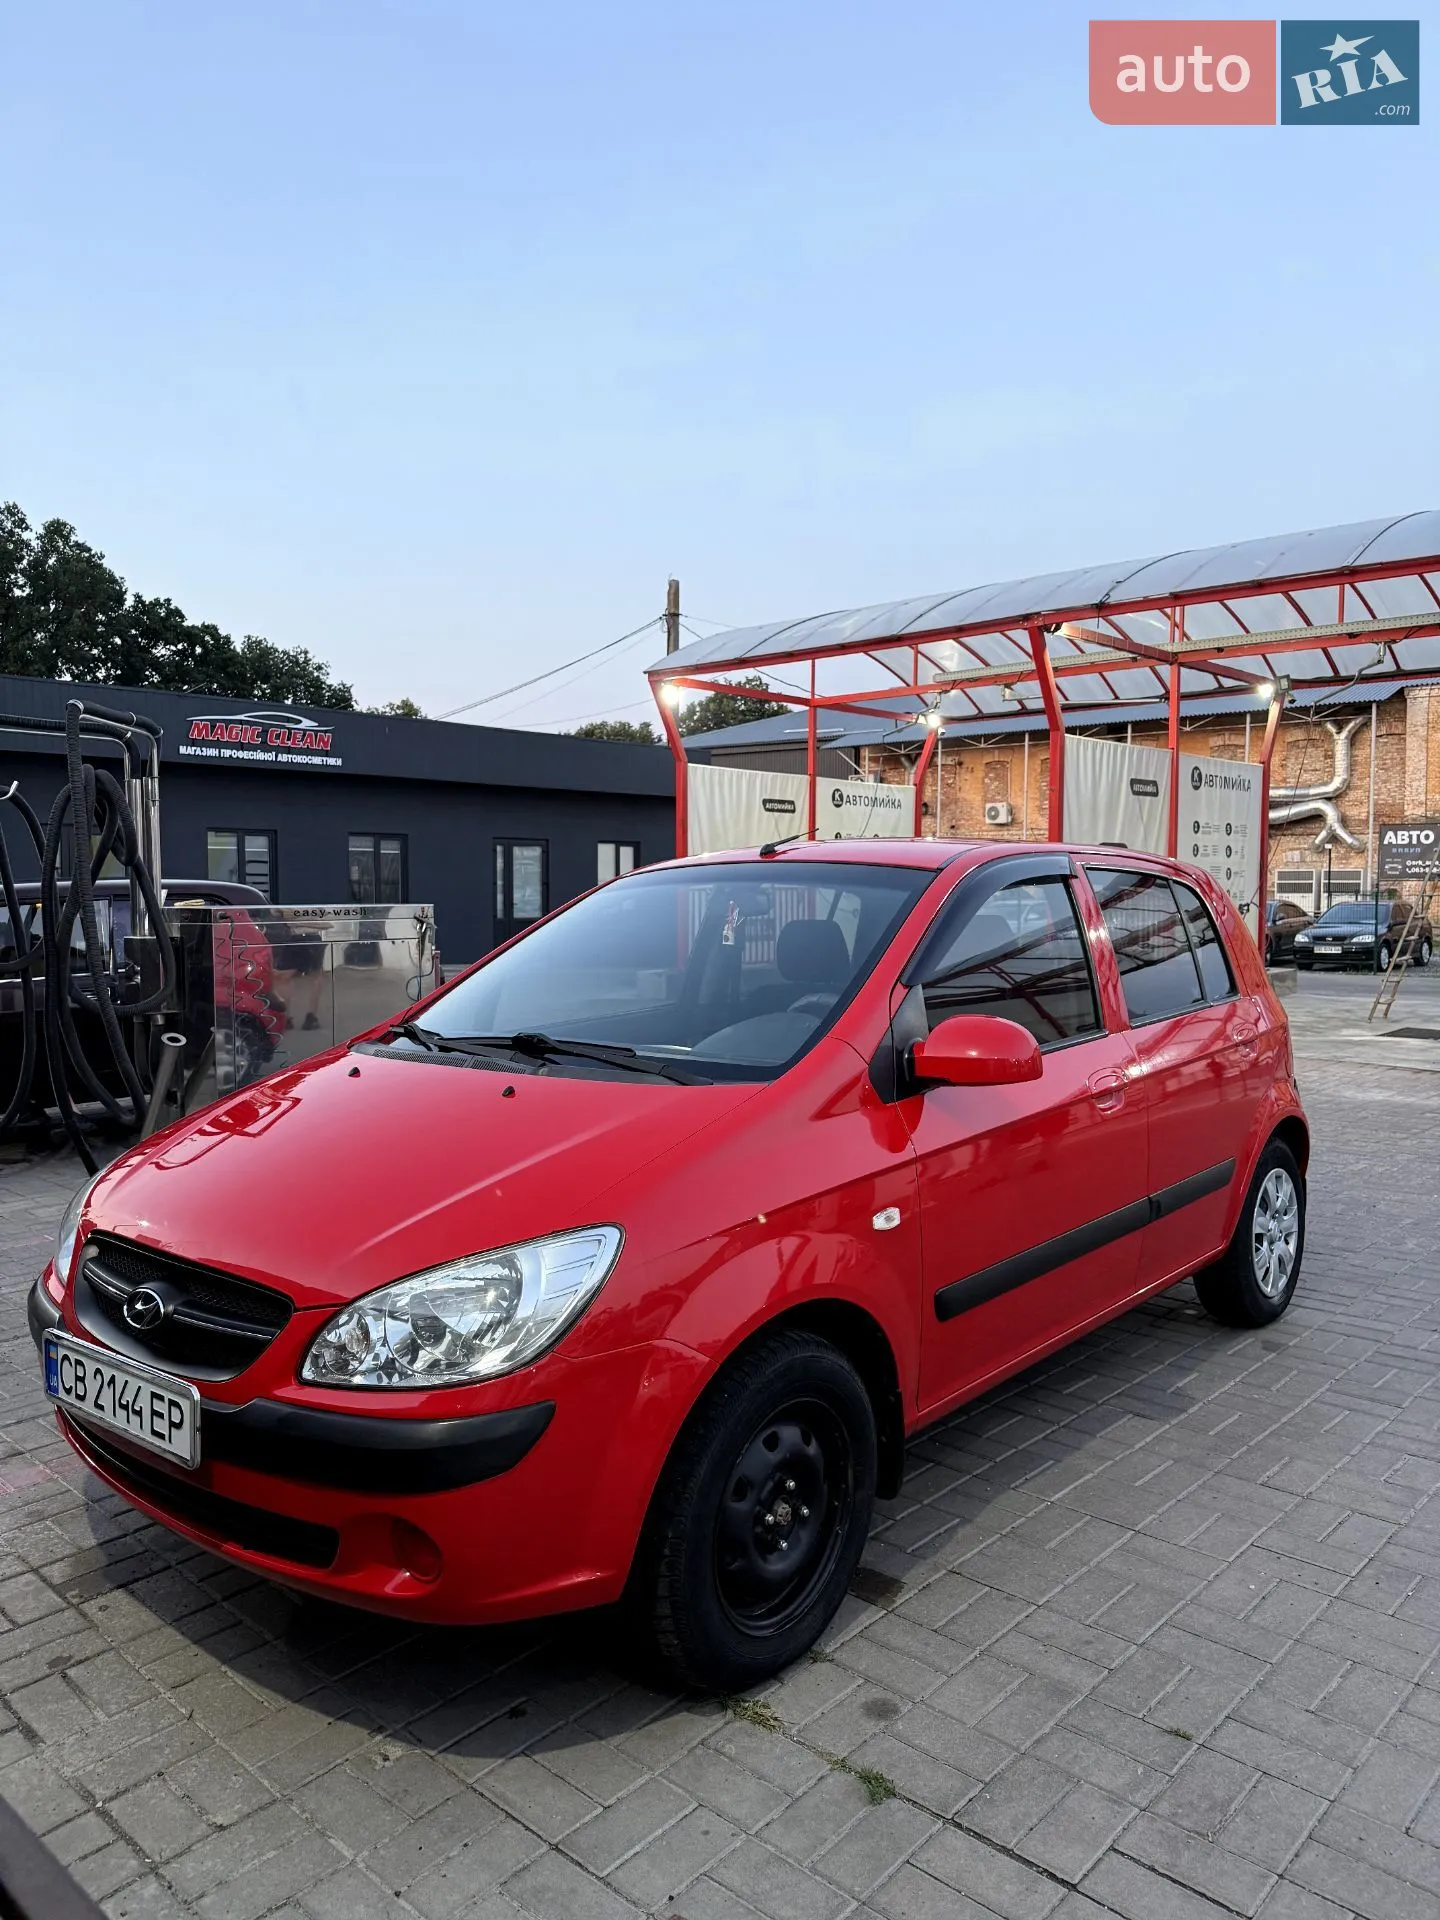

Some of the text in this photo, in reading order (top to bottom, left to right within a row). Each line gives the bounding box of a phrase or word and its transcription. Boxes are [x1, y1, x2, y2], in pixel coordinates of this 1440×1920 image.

[188, 720, 332, 750] MAGIC CLEAN
[179, 745, 342, 767] МАГАЗИН ПРОФЕСІЙНОЇ АВТОКОСМЕТИКИ
[1203, 773, 1252, 793] АВТОМИЙКА
[845, 794, 902, 810] АВТОМИЙКА
[1383, 830, 1434, 845] АВТО
[293, 907, 367, 918] easy-wash
[49, 1373, 58, 1388] UA
[60, 1353, 184, 1444] CB 2144 EP
